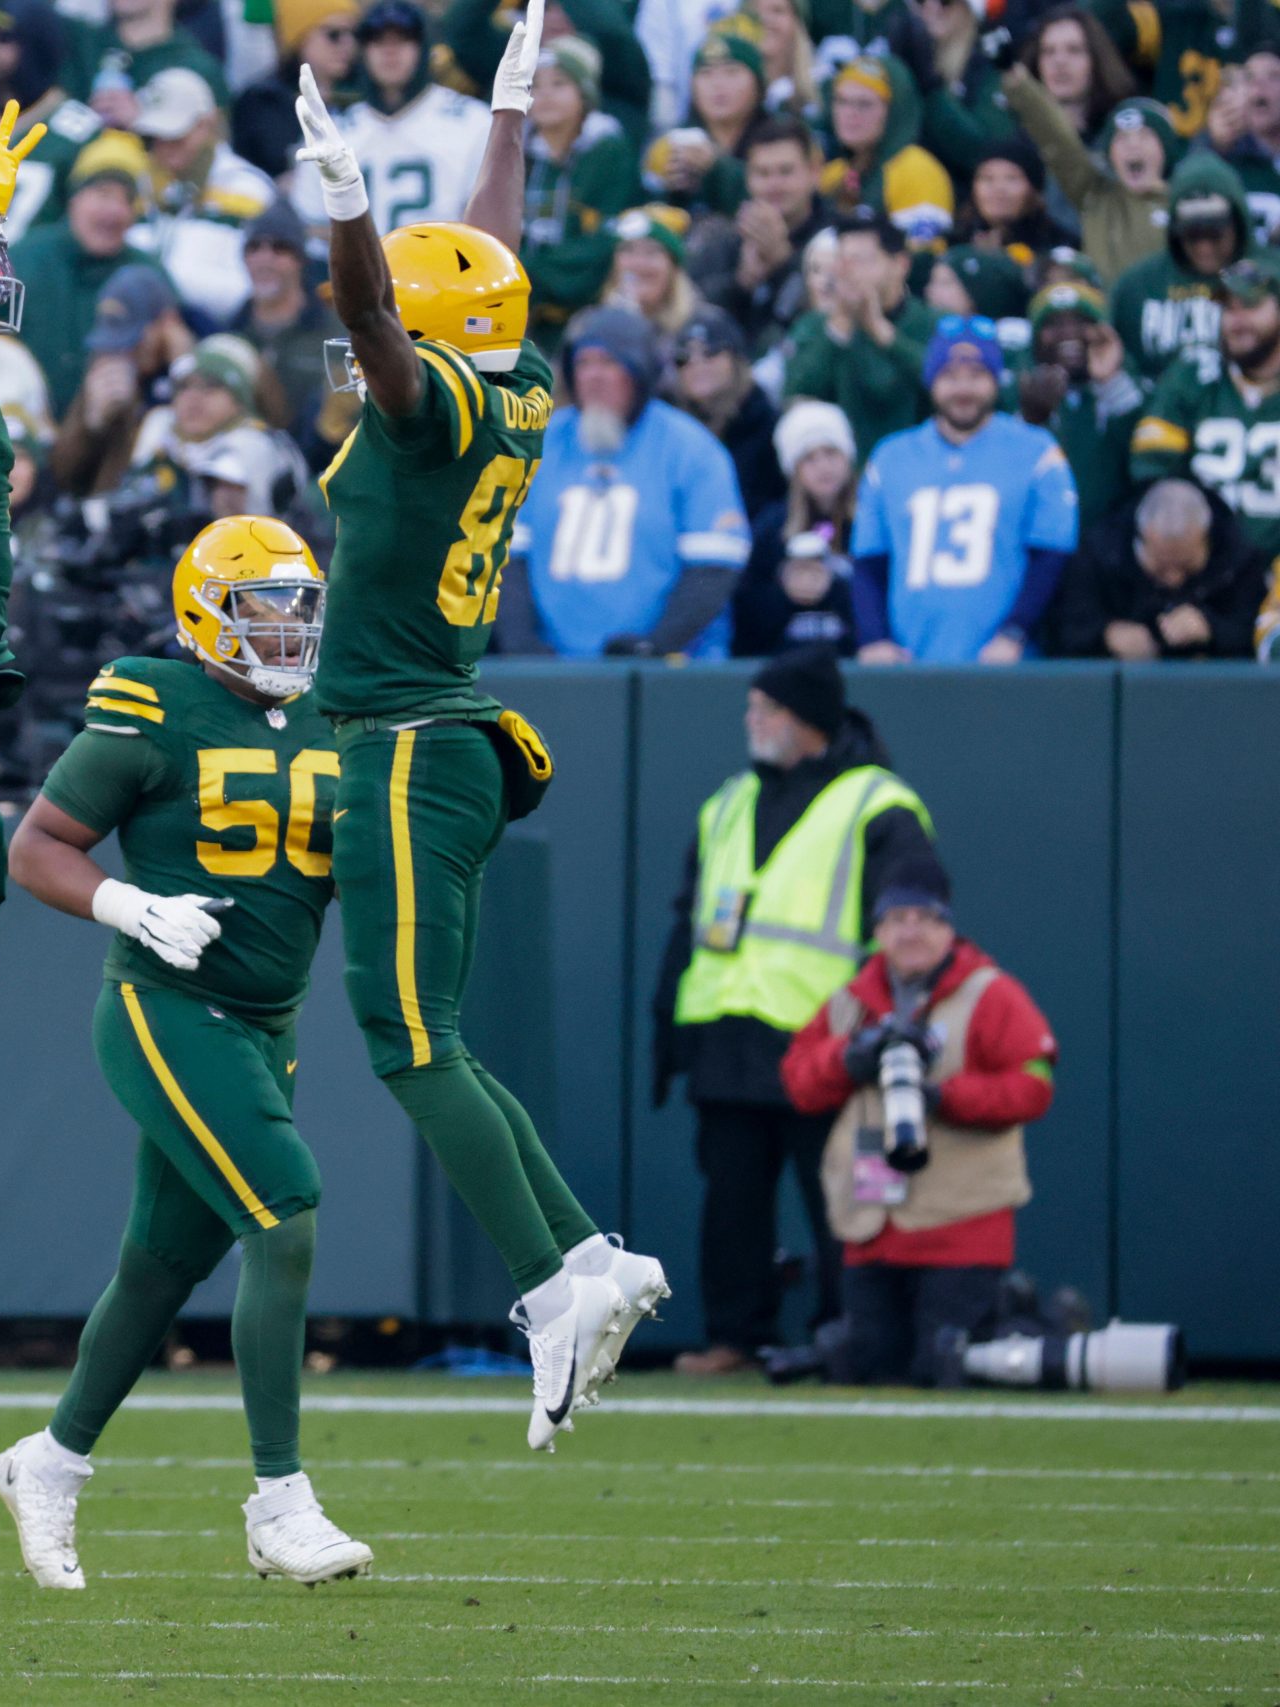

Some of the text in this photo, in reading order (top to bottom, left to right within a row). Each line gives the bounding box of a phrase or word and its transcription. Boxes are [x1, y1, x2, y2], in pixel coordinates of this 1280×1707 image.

[436, 454, 542, 627] 8
[549, 485, 639, 582] 10
[905, 484, 1000, 590] 13
[196, 748, 341, 877] 50
